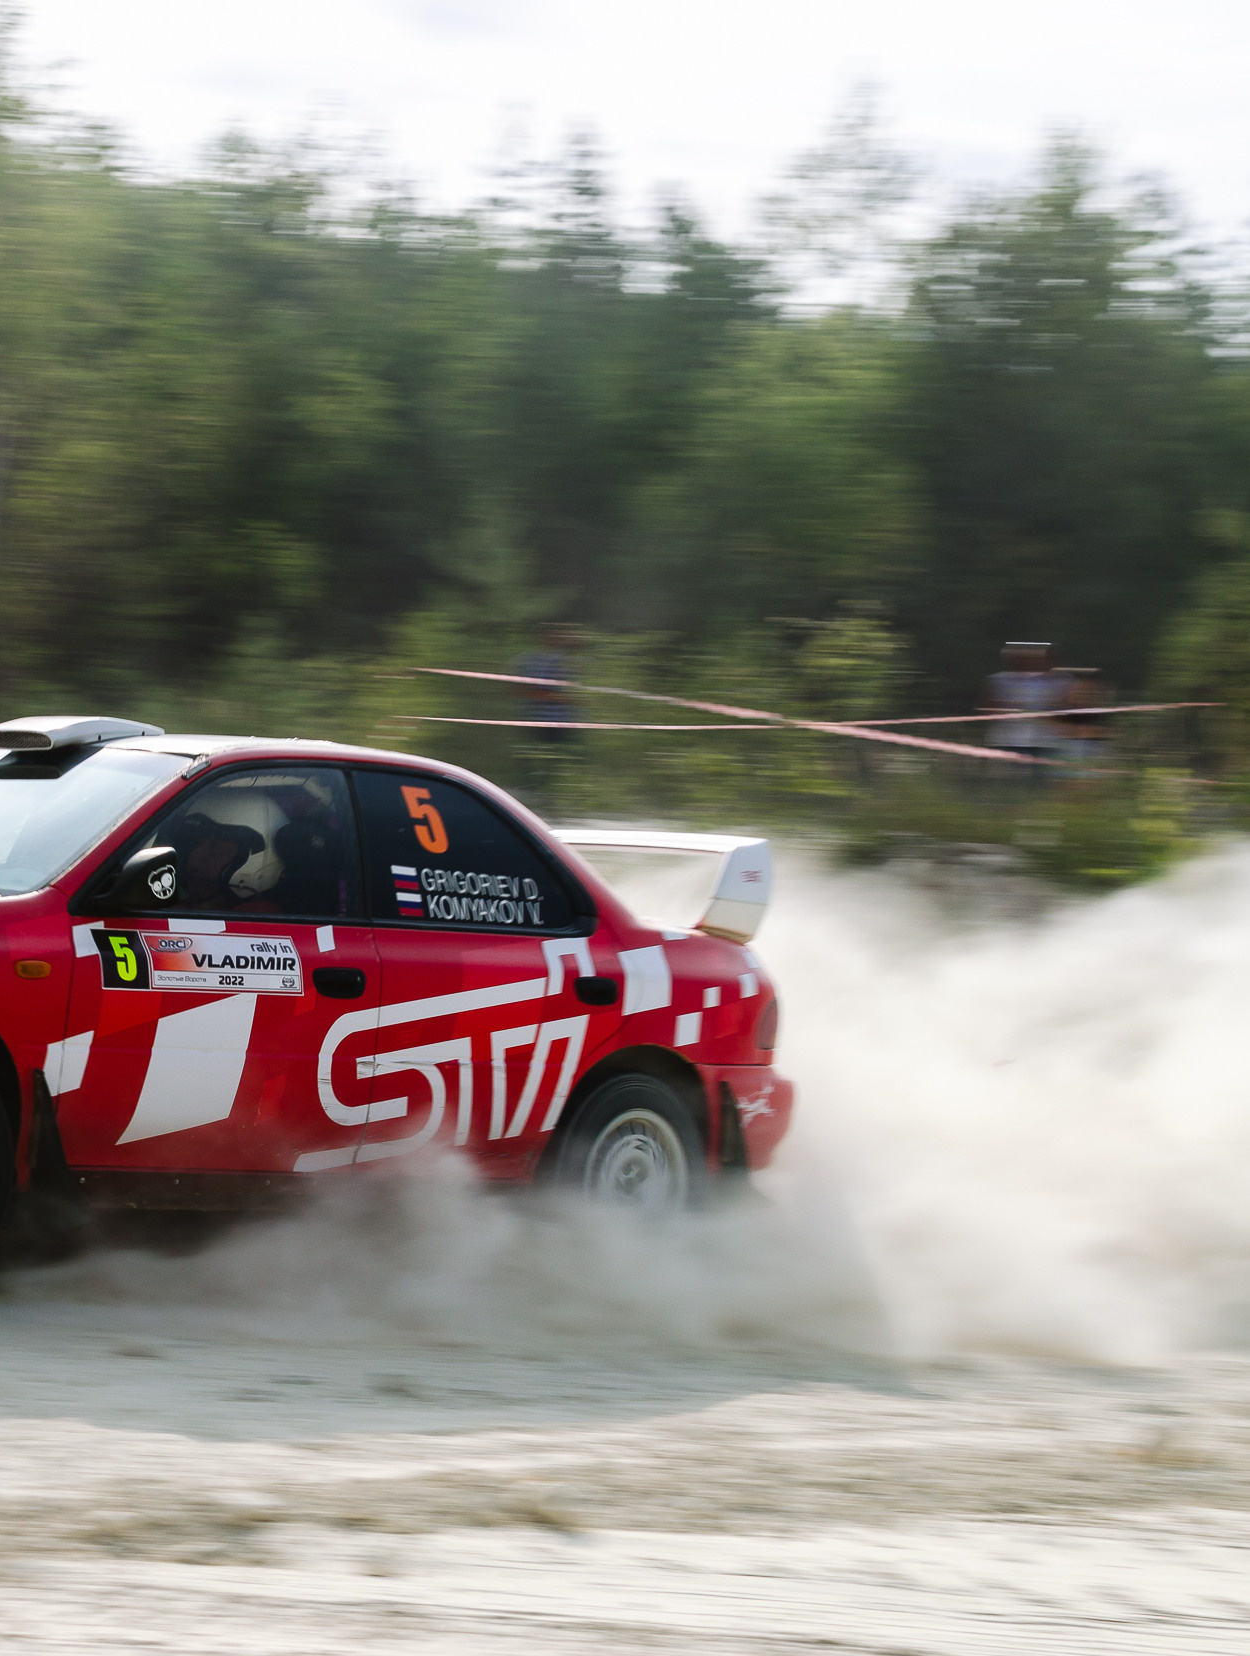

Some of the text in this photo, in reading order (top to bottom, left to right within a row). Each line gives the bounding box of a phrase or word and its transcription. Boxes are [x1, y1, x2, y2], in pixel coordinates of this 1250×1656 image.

[400, 785, 449, 854] 5
[420, 867, 545, 901] GRIGORIEV D.
[426, 893, 525, 925] KOMYAKOV
[108, 936, 138, 982] 5
[192, 953, 297, 972] VLADIMIR
[250, 942, 293, 955] rally in
[218, 974, 245, 986] 2022
